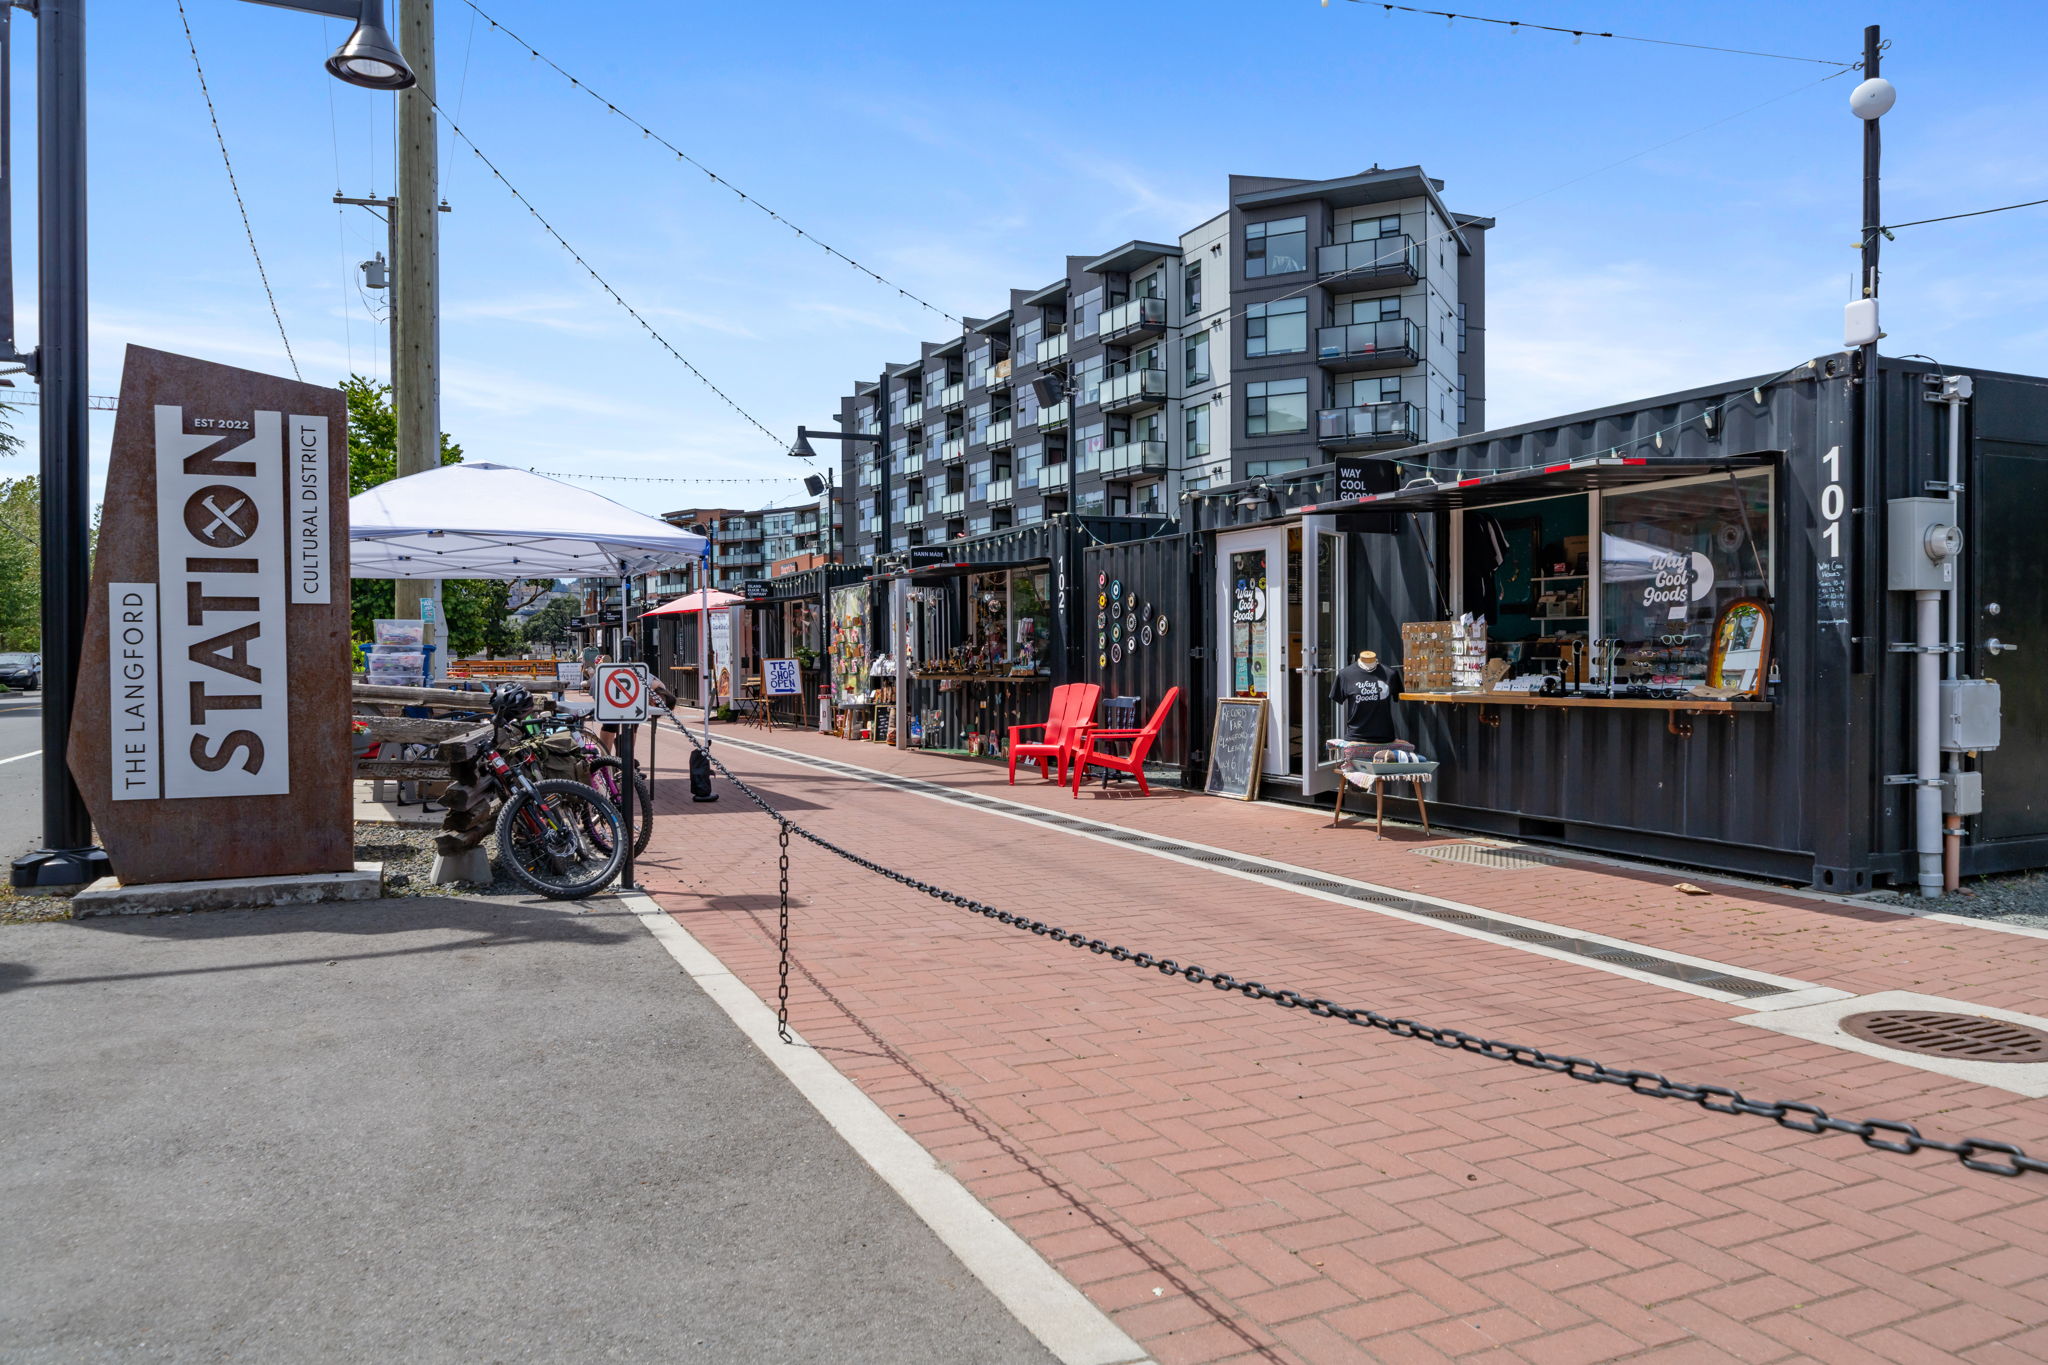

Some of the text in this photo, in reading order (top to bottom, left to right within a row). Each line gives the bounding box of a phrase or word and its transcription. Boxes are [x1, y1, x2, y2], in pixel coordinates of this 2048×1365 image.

[194, 418, 250, 430] EST 2022
[1340, 467, 1361, 479] WAY
[1340, 479, 1367, 491] COOL
[1820, 445, 1845, 558] 101
[300, 424, 320, 594] CULTURAL DISTRICT
[1648, 551, 1688, 573] Way
[1655, 570, 1690, 588] Cool
[1235, 586, 1254, 601] Way
[181, 432, 265, 776] STATION
[1238, 599, 1255, 611] Cool
[770, 661, 795, 671] TEA
[770, 670, 796, 680] SHOP
[770, 679, 796, 689] OPEN
[1355, 680, 1376, 689] Way
[122, 592, 147, 790] THE LANGFORD
[1360, 687, 1379, 696] Cool
